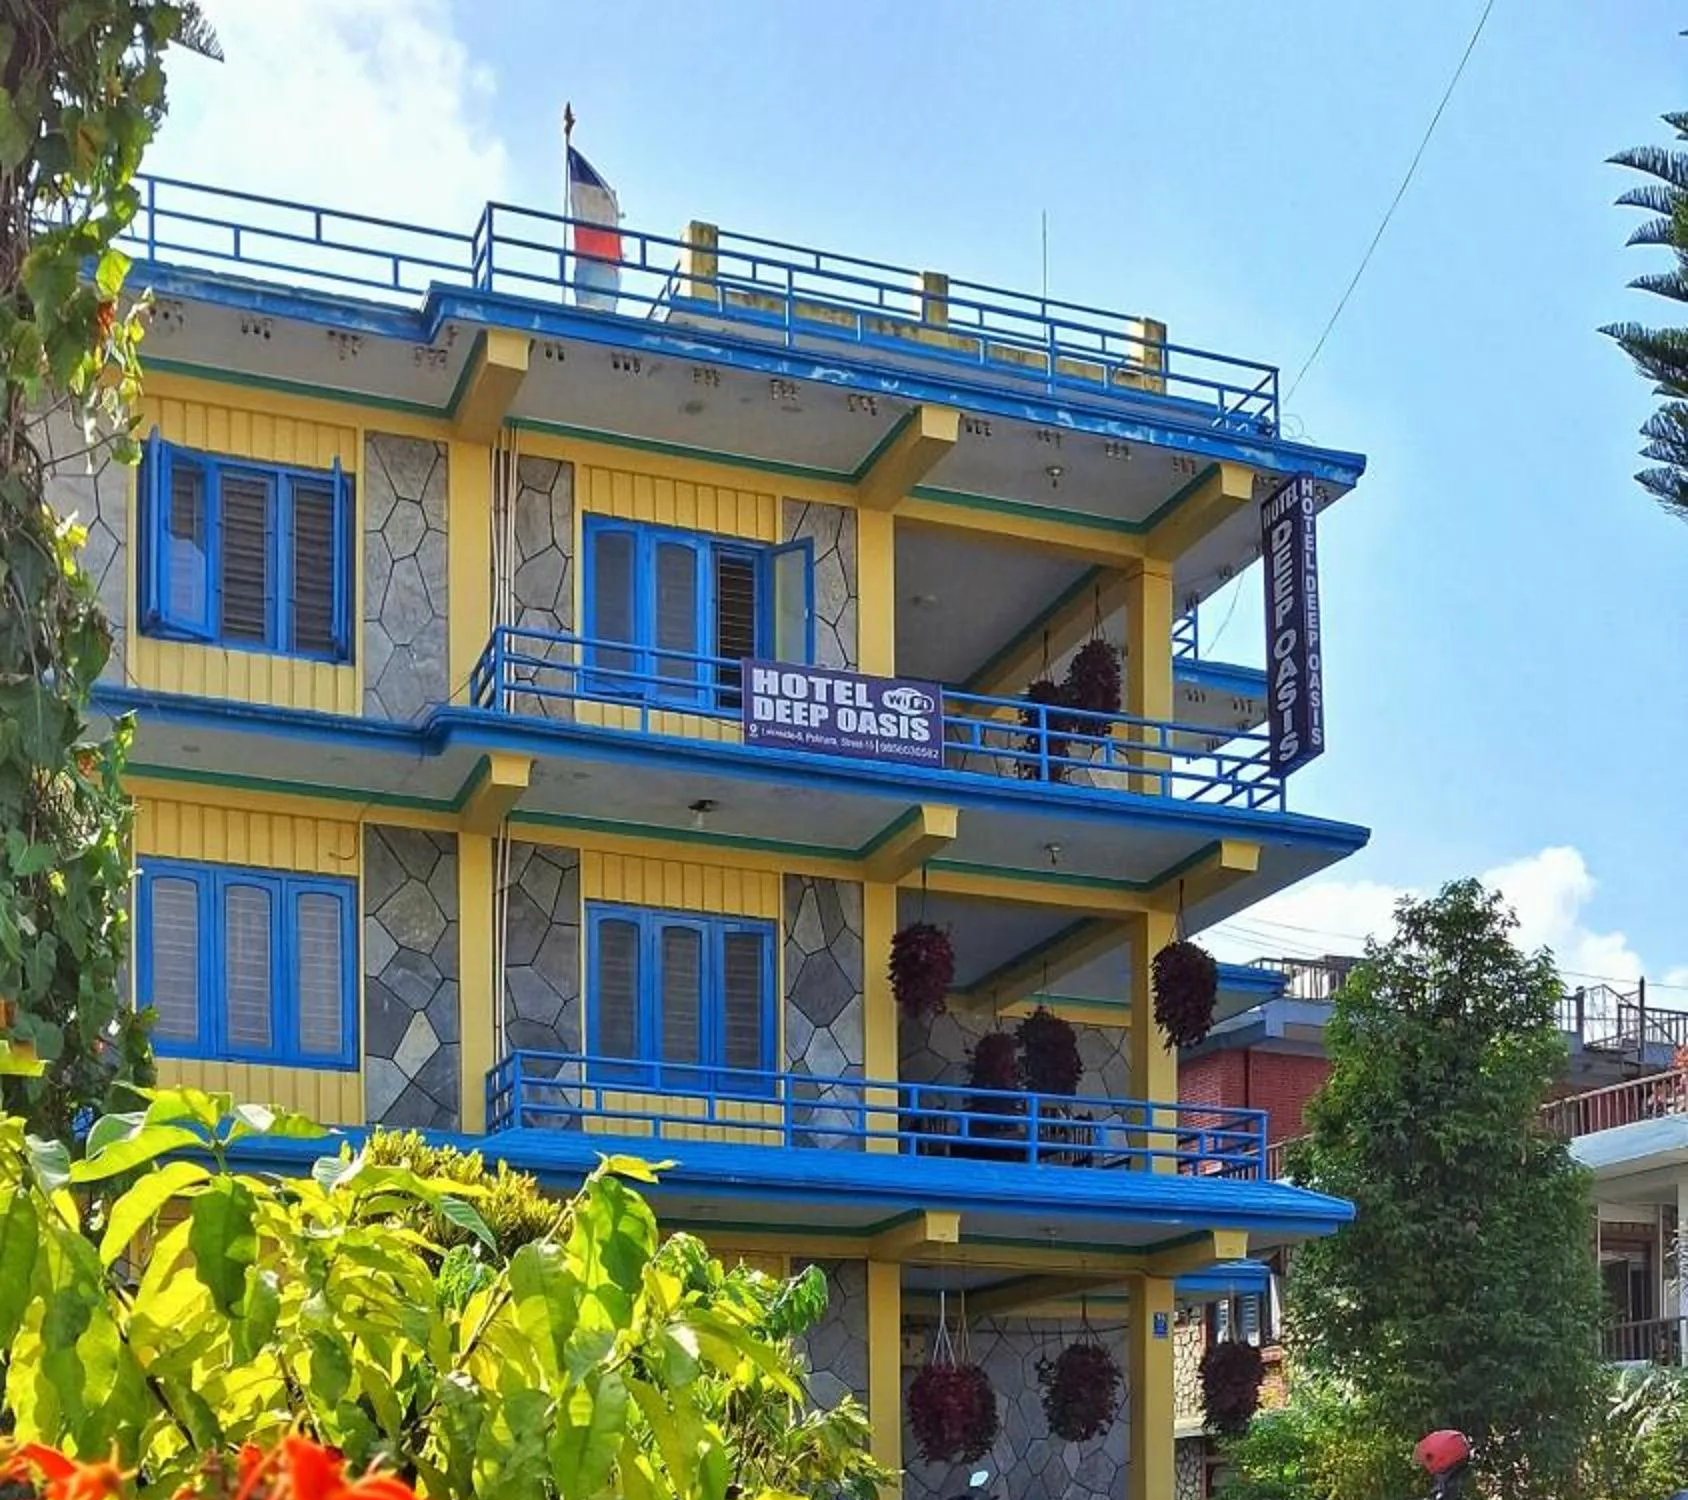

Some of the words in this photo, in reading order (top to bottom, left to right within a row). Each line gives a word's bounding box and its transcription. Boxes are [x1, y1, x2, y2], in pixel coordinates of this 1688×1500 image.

[1264, 481, 1298, 529] HOTEL
[1302, 478, 1315, 570] HOTEL
[1272, 520, 1293, 629] DEEP
[1305, 575, 1318, 647] DEEP
[753, 668, 873, 708] HOTEL
[753, 696, 829, 727] DEEP
[837, 708, 930, 741] OASIS
[1273, 629, 1298, 761] OASIS
[1308, 654, 1321, 745] OASIS
